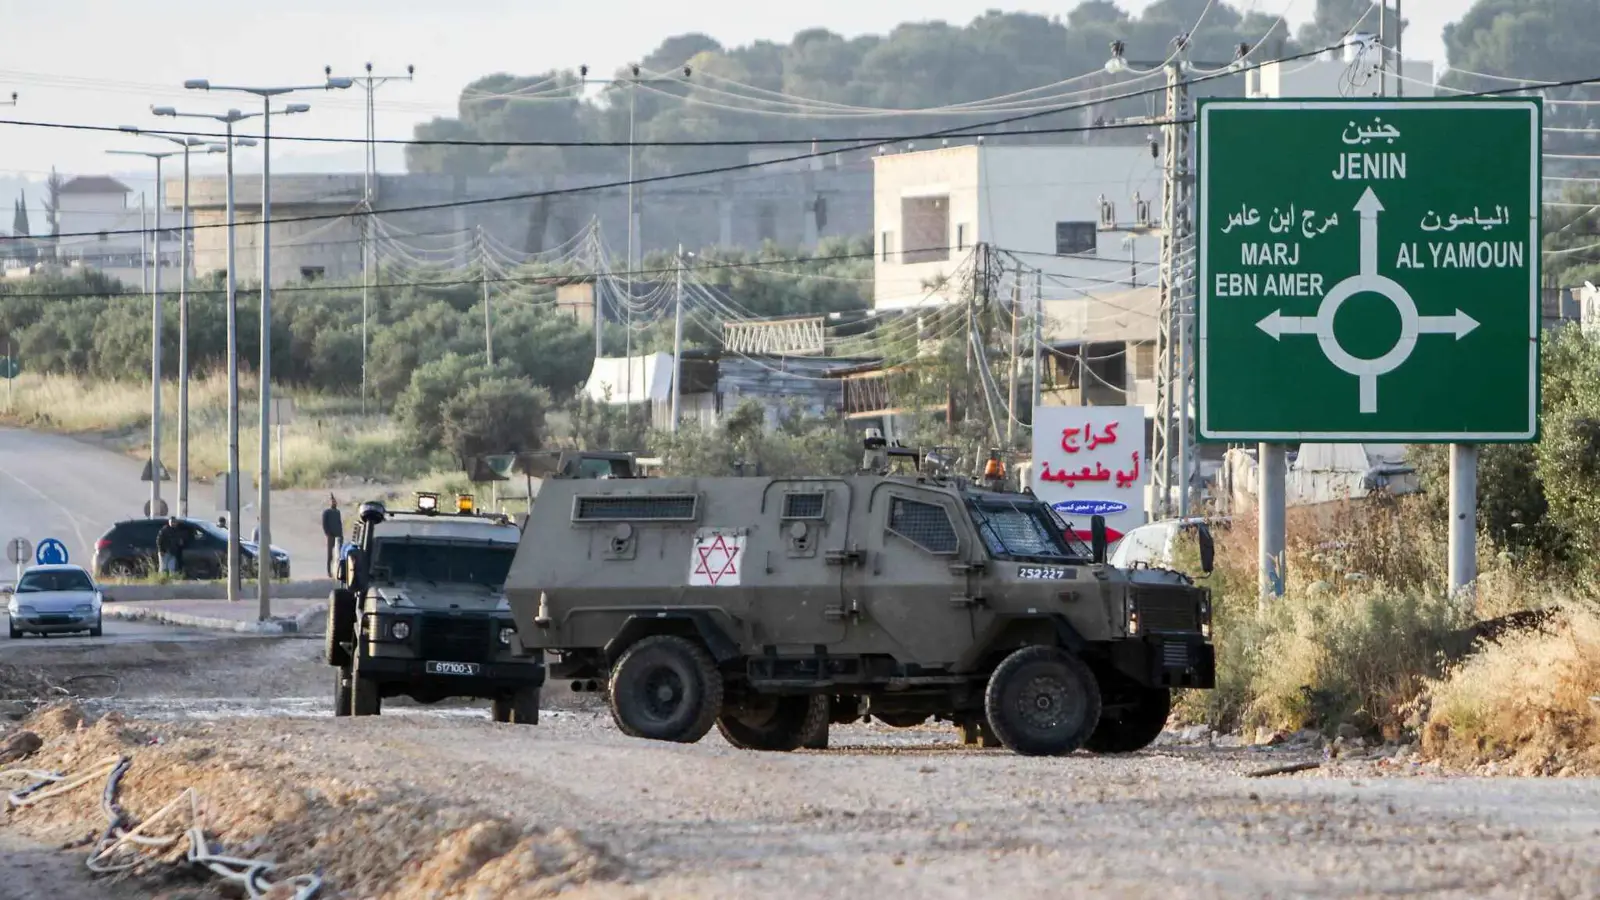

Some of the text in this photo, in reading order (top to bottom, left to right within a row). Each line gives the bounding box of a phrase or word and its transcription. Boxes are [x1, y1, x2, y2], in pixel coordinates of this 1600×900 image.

[1342, 117, 1401, 144] جنين
[1332, 152, 1407, 180] JENIN
[1220, 201, 1339, 239] مرج ابن عامر
[1241, 242, 1300, 266] MARJ
[1396, 241, 1524, 269] AL YAMOUN
[1215, 273, 1324, 297] EBN AMER
[1061, 421, 1119, 454] كراج
[1041, 450, 1139, 488] أبو طعيمة
[1019, 568, 1065, 579] 252227
